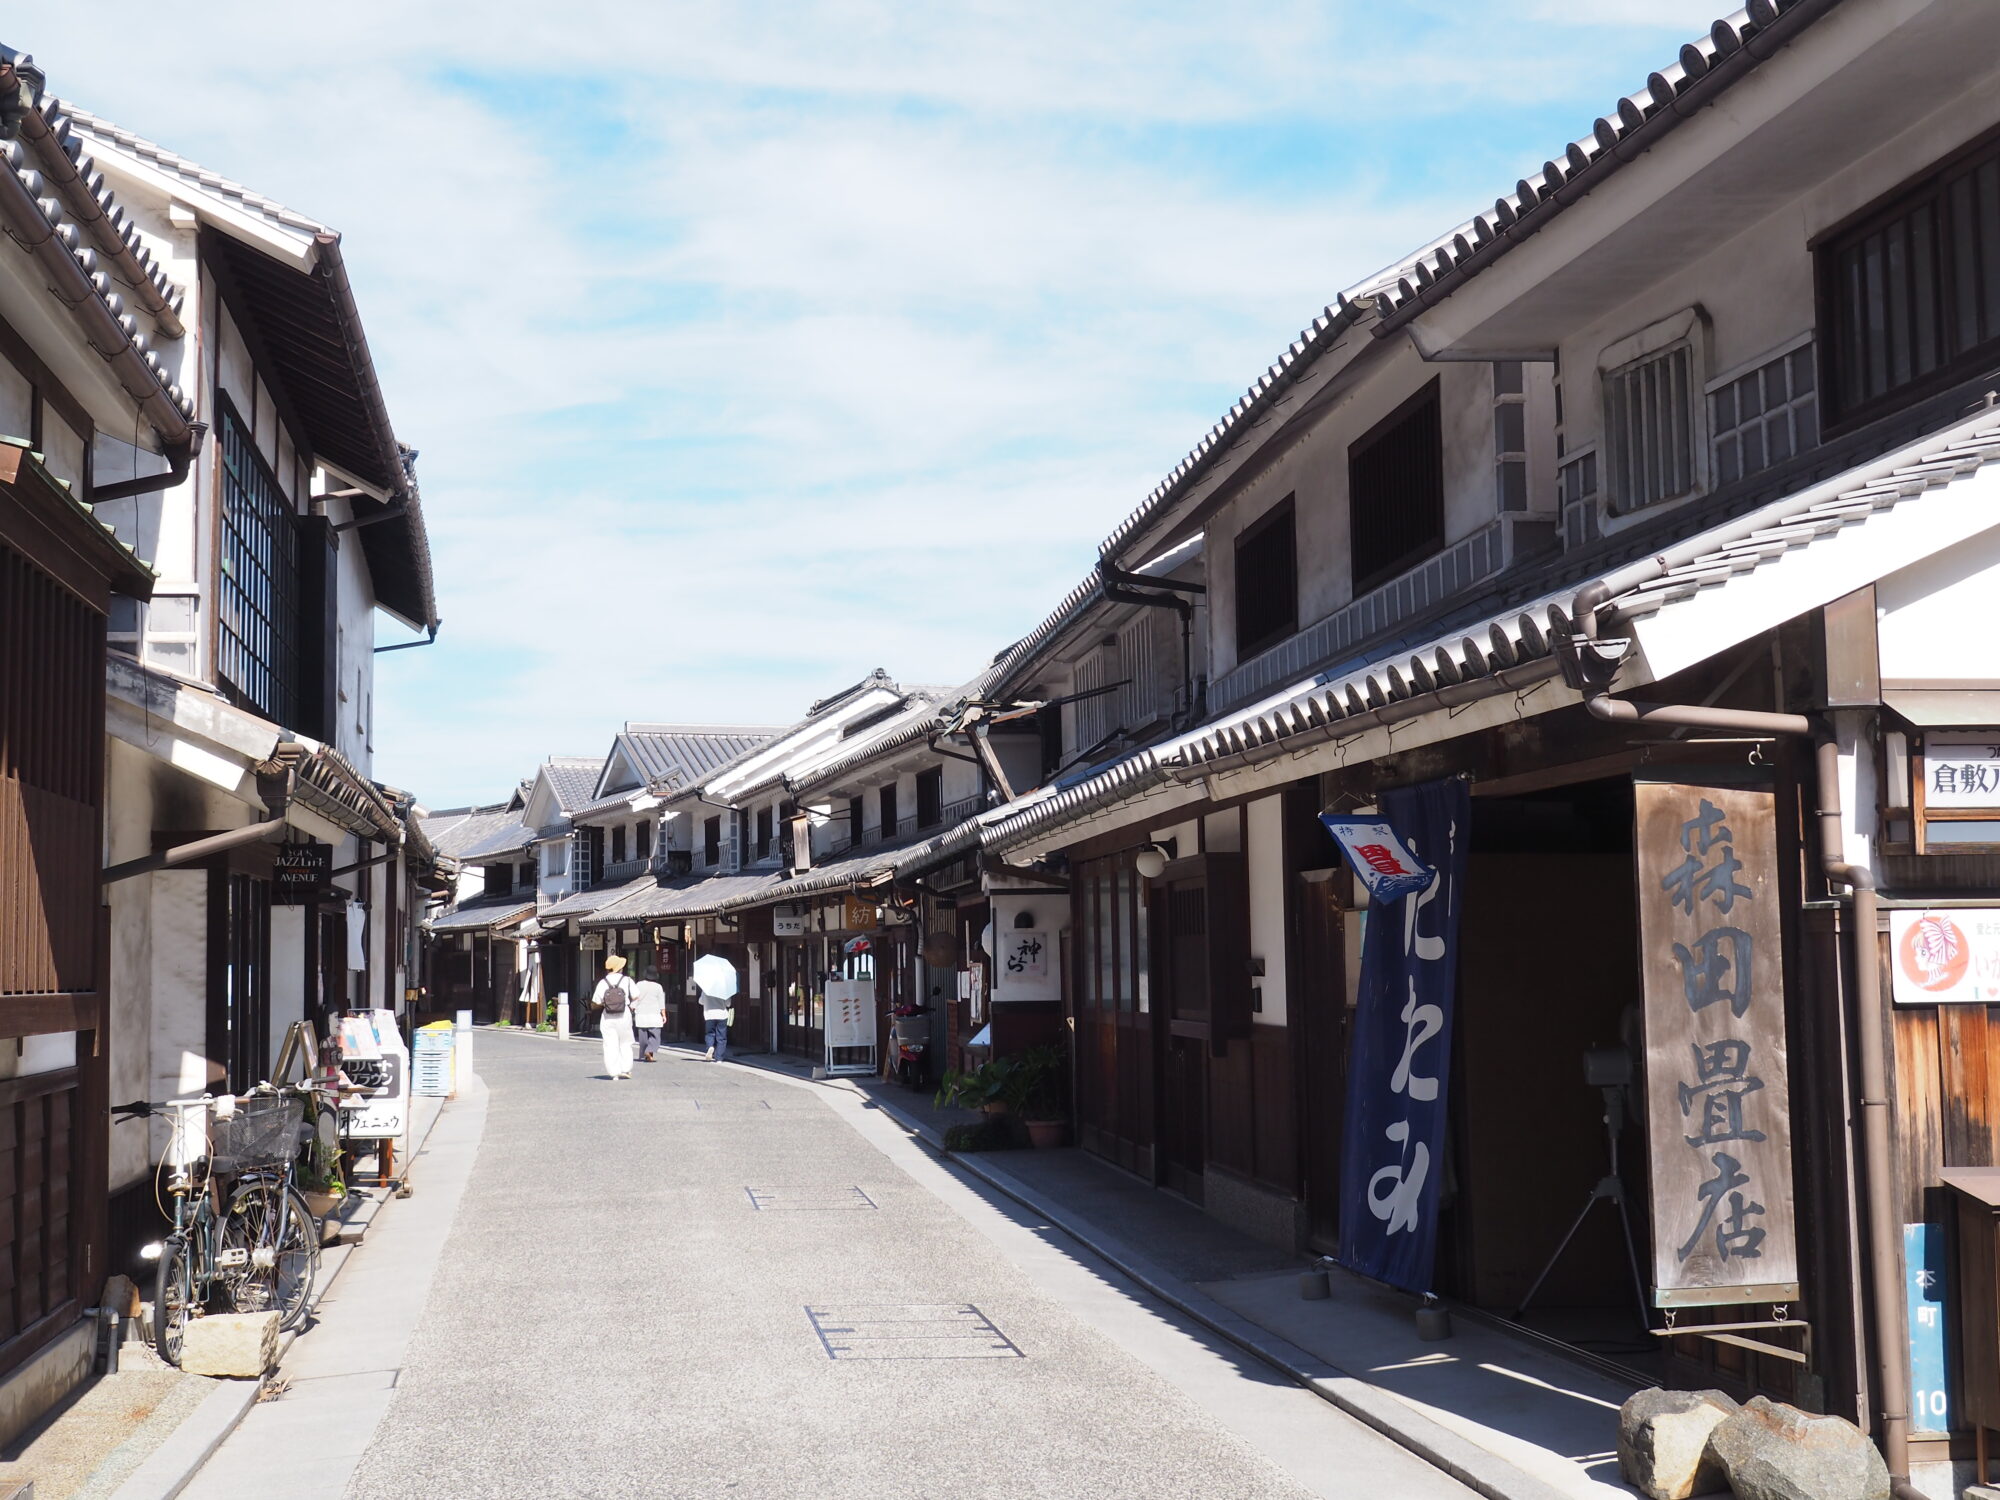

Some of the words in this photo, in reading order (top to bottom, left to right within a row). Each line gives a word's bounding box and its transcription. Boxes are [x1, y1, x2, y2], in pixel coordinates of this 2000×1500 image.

[1986, 746, 2000, 759] つ
[274, 856, 299, 867] JAZZ
[280, 873, 318, 882] AVENUE
[851, 906, 871, 925] 紡
[777, 922, 800, 930] うちだ
[1367, 837, 1446, 1237] たたみ
[1662, 798, 1767, 1262] 森田畳店
[1915, 1269, 1937, 1327] 本町
[1916, 1390, 1947, 1416] 10
